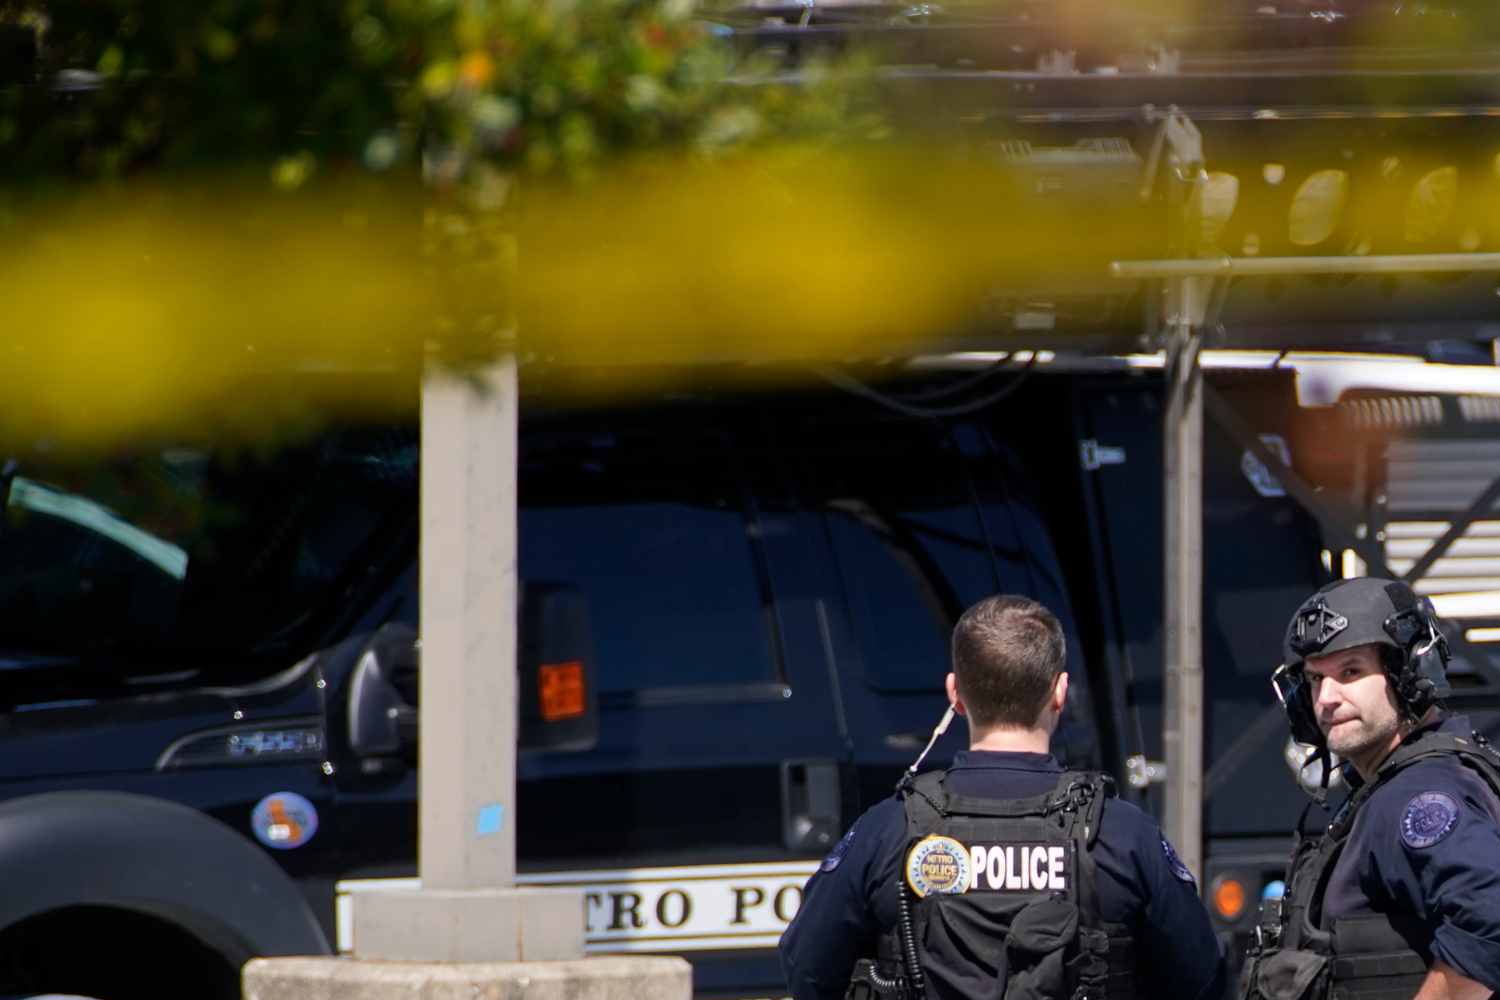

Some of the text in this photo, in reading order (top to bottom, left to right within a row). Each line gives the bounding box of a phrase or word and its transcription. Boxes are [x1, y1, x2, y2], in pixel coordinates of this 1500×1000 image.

[927, 854, 953, 864] METRO
[922, 863, 958, 876] POLICE
[970, 845, 1065, 890] POLICE
